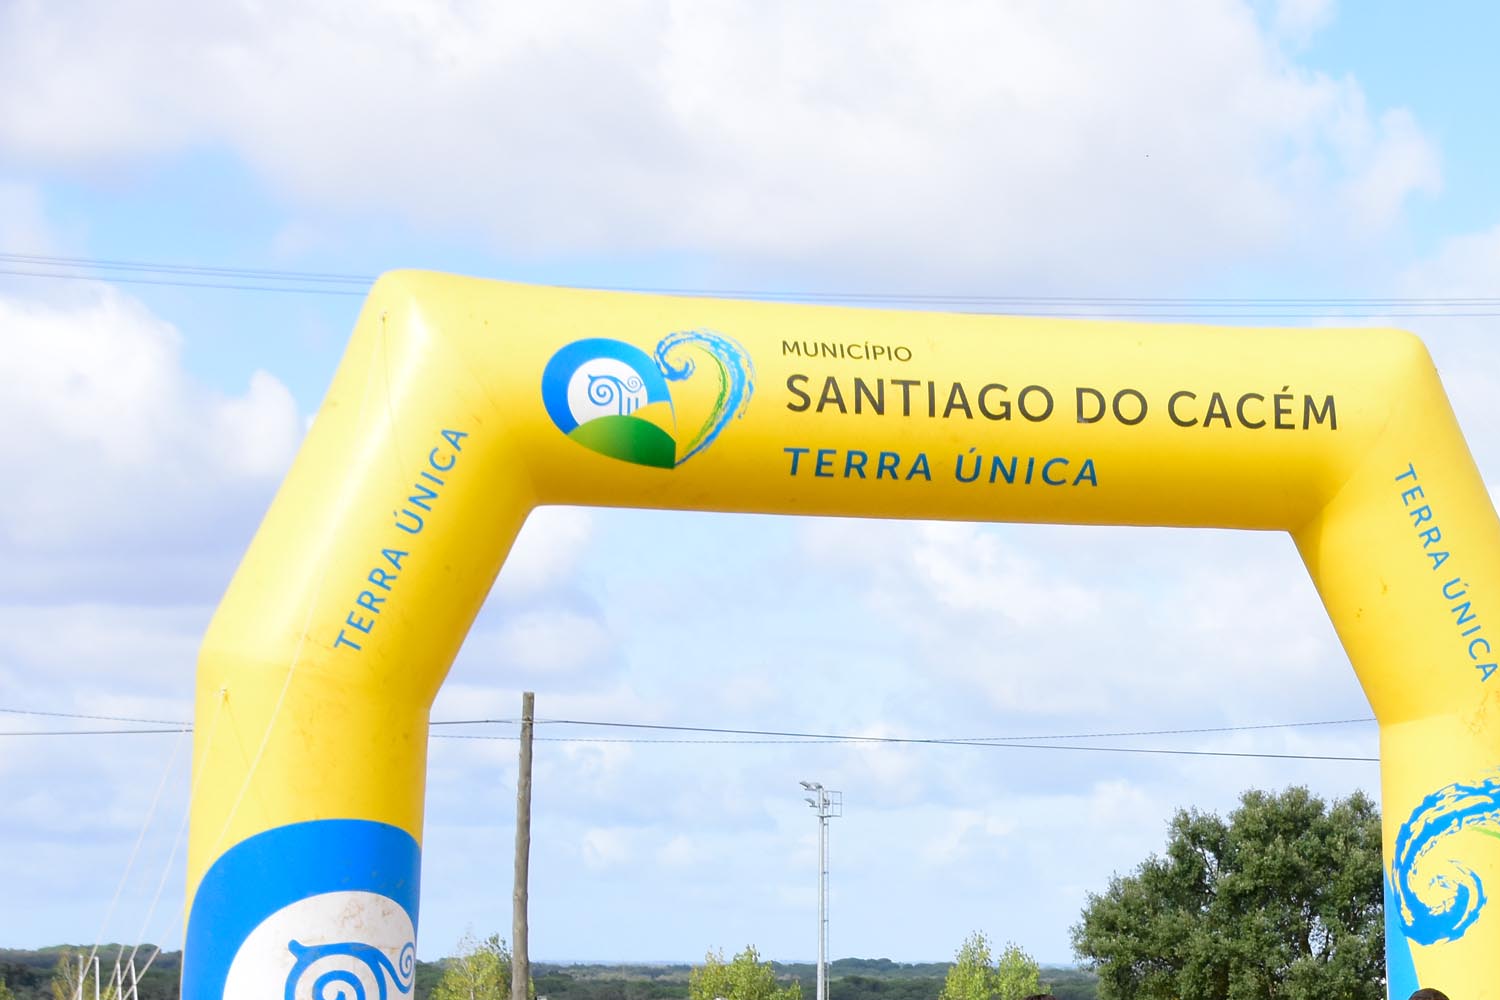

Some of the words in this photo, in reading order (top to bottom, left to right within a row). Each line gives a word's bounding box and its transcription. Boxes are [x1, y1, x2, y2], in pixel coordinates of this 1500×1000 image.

[782, 340, 912, 362] MUNICÍPIO
[786, 374, 1055, 422] SANTIAGO
[1076, 387, 1148, 425] DO
[1168, 385, 1337, 430] CACÉM
[784, 447, 932, 481] TERRA
[955, 447, 1098, 487] ÚNICA
[333, 548, 409, 651] TERRA
[393, 429, 469, 534] ÚNICA
[1395, 462, 1450, 570] TERRA
[1442, 577, 1499, 682] ÚNICA
